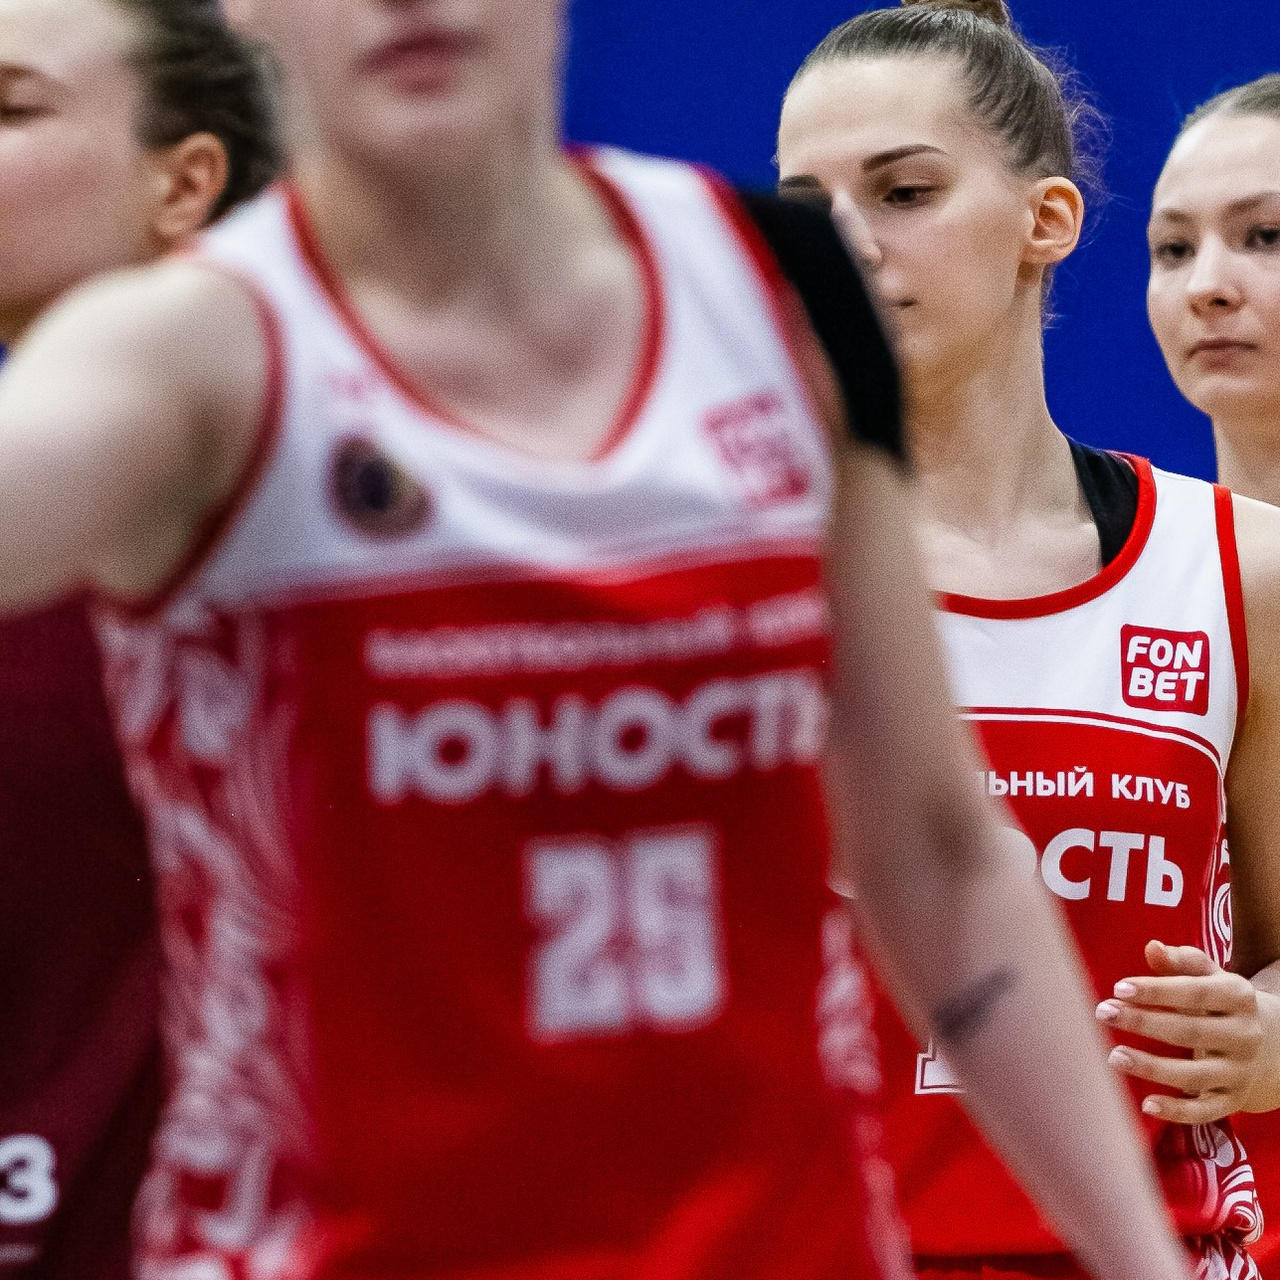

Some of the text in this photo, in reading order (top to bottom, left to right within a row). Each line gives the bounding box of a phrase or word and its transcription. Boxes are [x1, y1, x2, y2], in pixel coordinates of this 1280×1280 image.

[1126, 636, 1203, 669] FON
[1128, 667, 1206, 702] BET
[1111, 774, 1190, 809] КЛУБ
[1003, 826, 1185, 908] СТЬ
